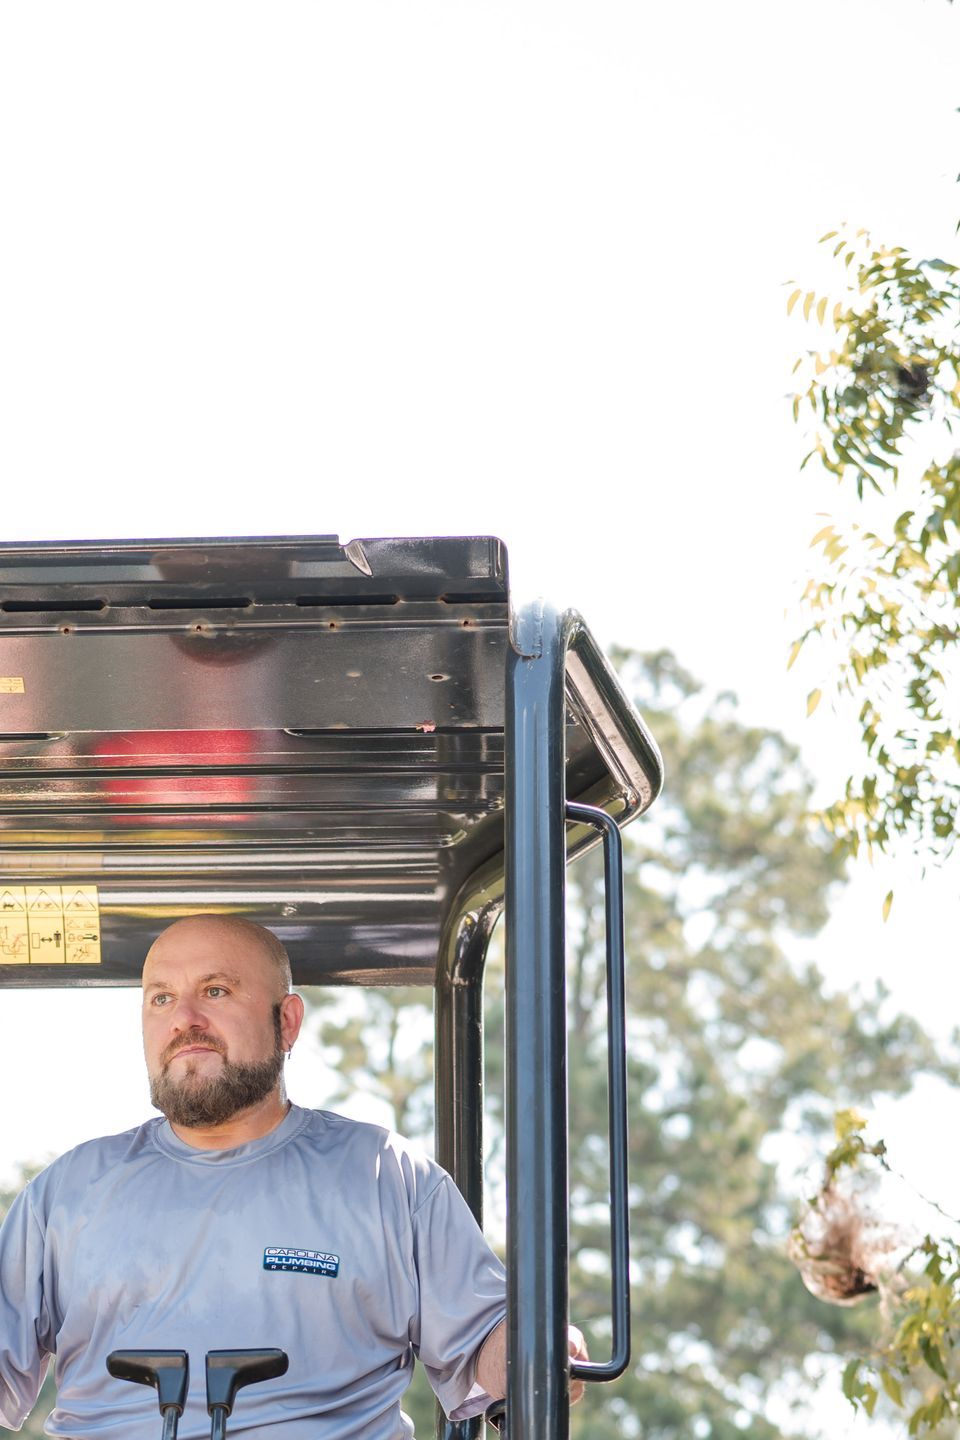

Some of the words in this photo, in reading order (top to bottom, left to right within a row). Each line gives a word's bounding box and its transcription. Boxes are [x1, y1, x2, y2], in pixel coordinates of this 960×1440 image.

[267, 1248, 336, 1262] CAROLINA
[266, 1257, 336, 1271] PLUMBING
[271, 1265, 327, 1274] REPAIR
